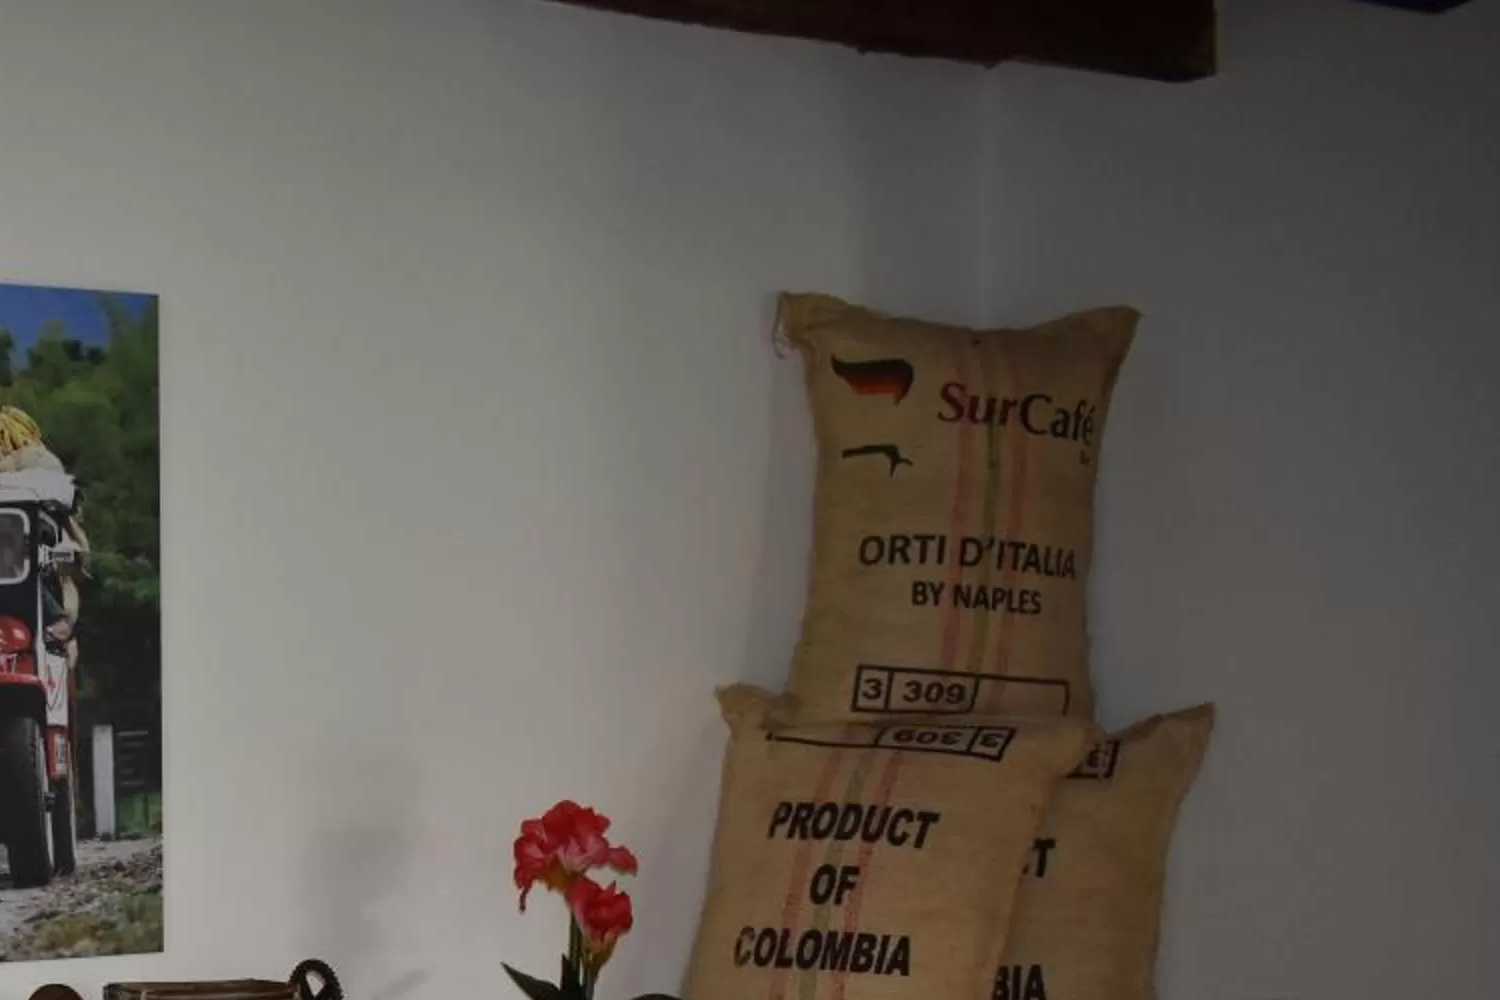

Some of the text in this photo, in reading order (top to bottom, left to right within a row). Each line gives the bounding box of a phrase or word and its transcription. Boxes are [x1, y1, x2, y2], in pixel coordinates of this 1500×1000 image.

[937, 382, 1096, 446] SurCafé
[859, 534, 1077, 579] ORTI D'ITALIA
[911, 581, 1042, 614] BY NAPLES
[862, 678, 966, 705] 3 309
[767, 802, 940, 849] PRODUCT
[810, 864, 860, 905] OF
[733, 926, 912, 976] COLOMBIA
